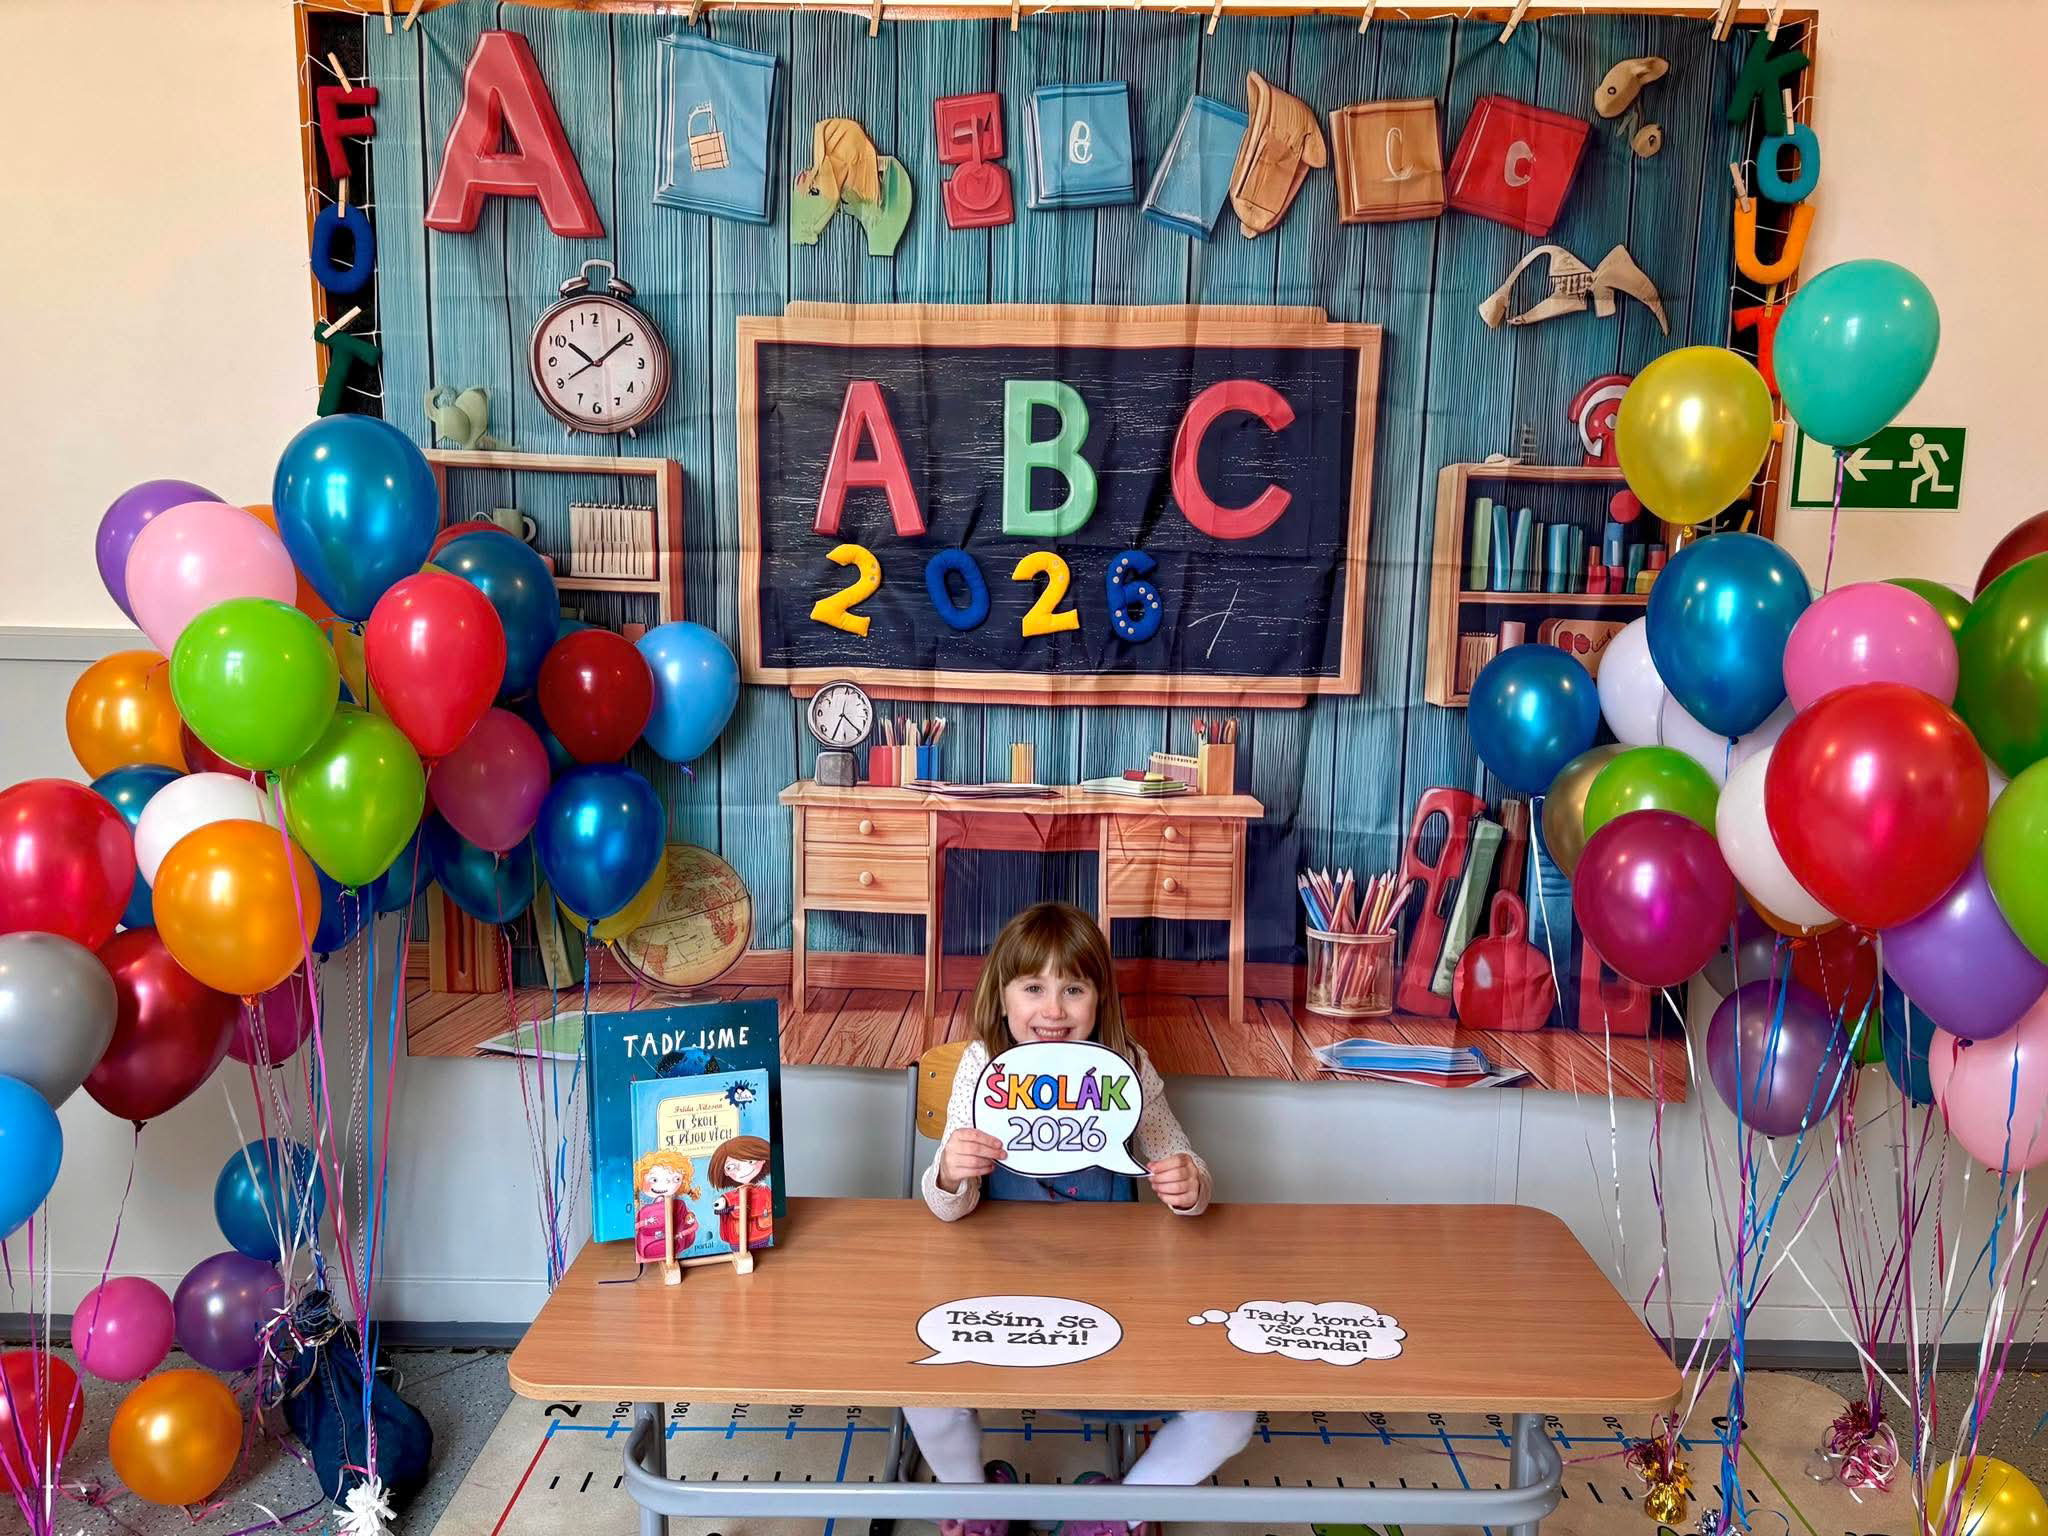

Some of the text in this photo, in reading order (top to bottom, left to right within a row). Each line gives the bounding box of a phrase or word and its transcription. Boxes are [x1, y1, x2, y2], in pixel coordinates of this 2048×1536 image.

[424, 29, 604, 238] A
[1728, 29, 1820, 442] KOUT
[809, 543, 1164, 643] 2026
[622, 1026, 750, 1058] TADY JSME
[983, 1063, 1131, 1111] ŠKOLÁK
[1007, 1116, 1108, 1152] 2026
[946, 1310, 1099, 1329] Těším se
[1243, 1308, 1387, 1328] Tady končí
[952, 1329, 1089, 1346] na září!
[1258, 1322, 1373, 1340] všechna
[1265, 1335, 1368, 1353] sranda!
[612, 1401, 633, 1419] 190
[671, 1401, 691, 1419] 180
[846, 1405, 862, 1420] 15
[1311, 1411, 1328, 1424] 70
[1369, 1412, 1387, 1425] 60
[1427, 1413, 1446, 1426] 50
[1486, 1414, 1503, 1428] 40
[1545, 1415, 1563, 1429] 30
[1603, 1416, 1623, 1430] 20
